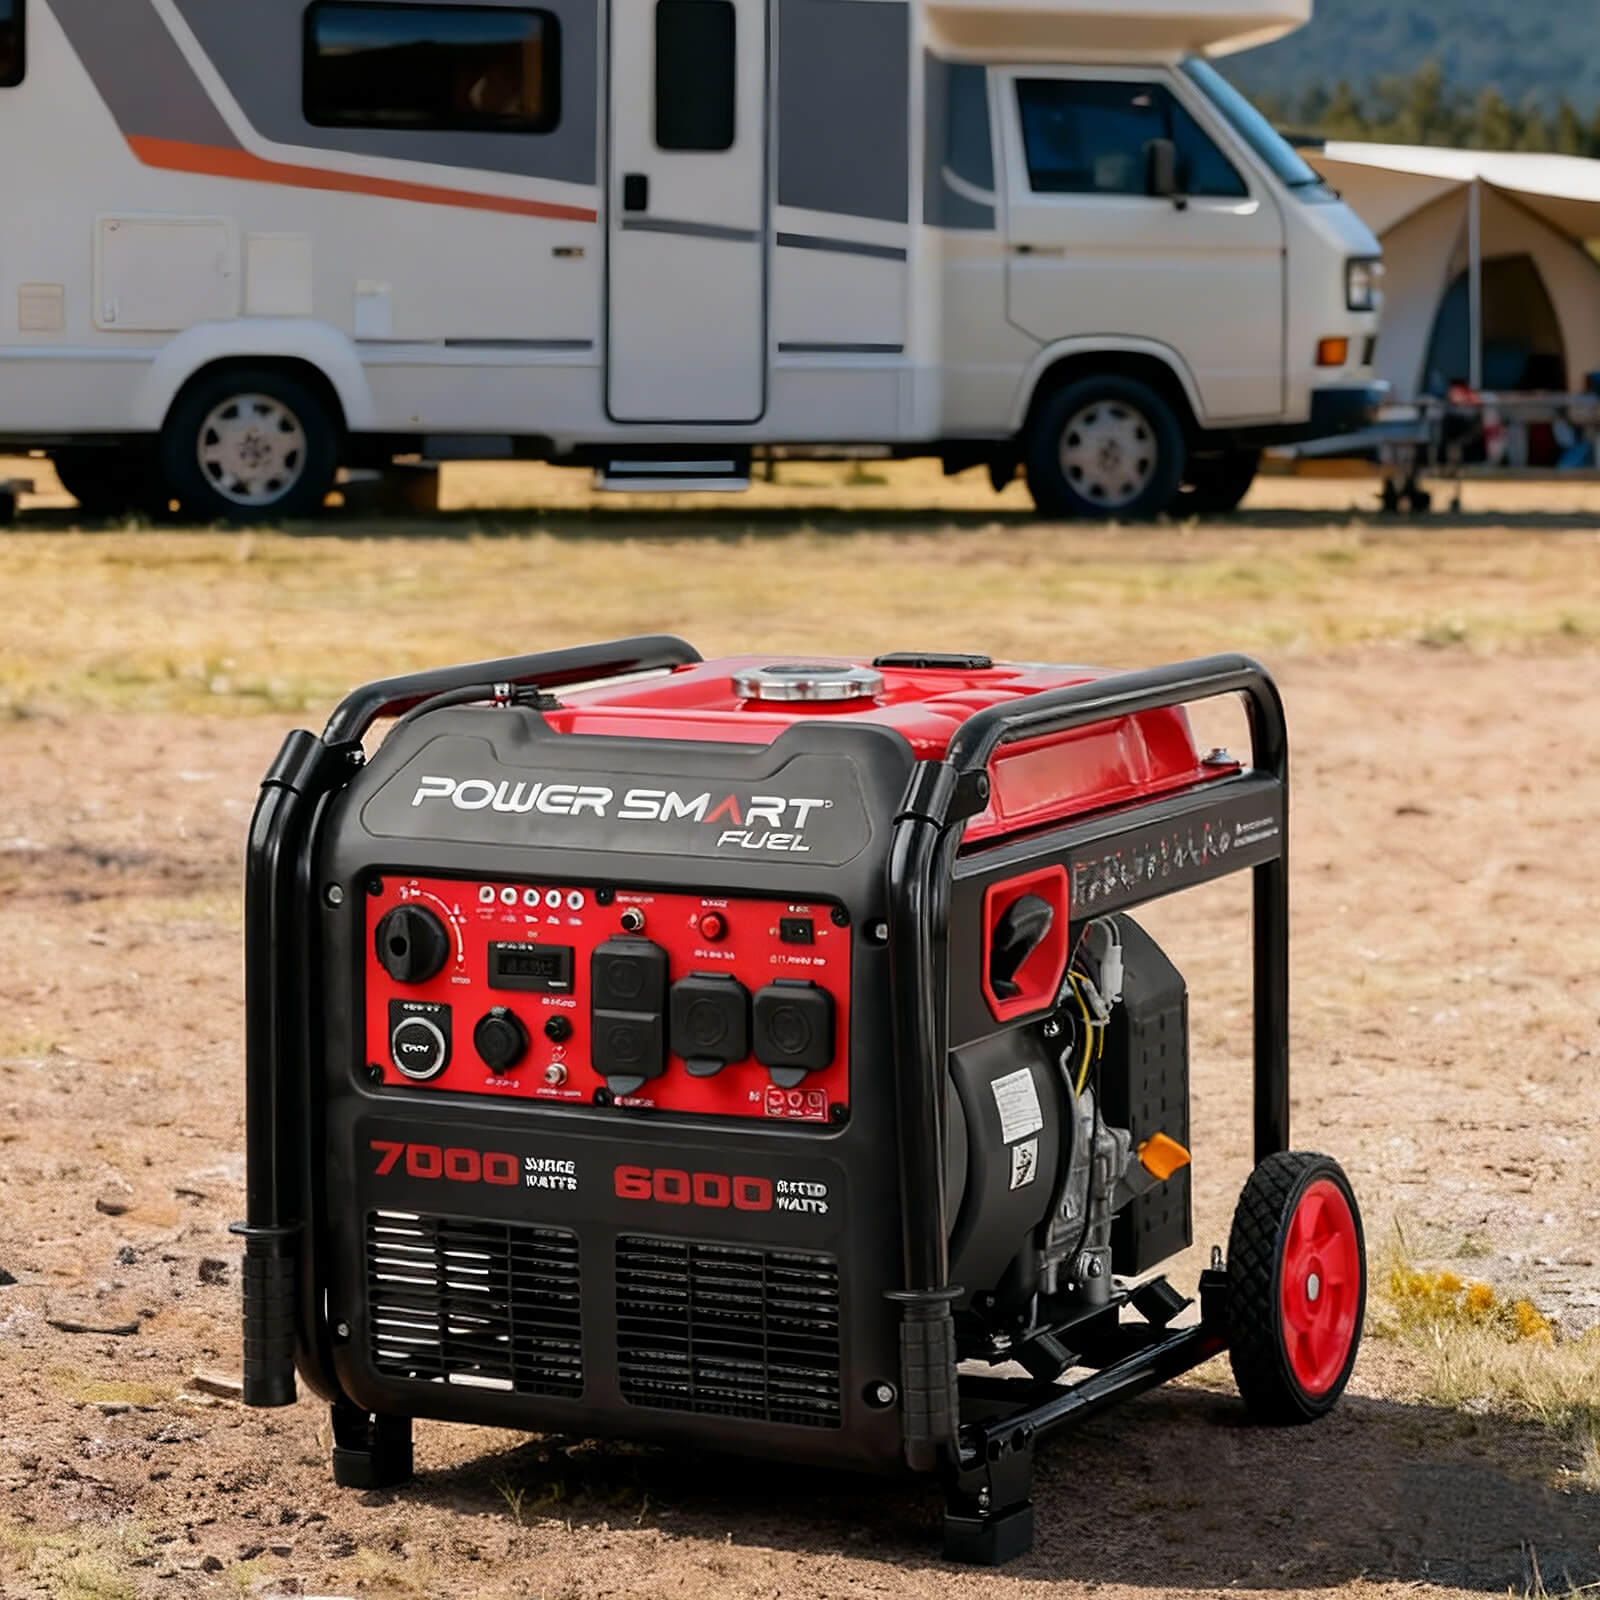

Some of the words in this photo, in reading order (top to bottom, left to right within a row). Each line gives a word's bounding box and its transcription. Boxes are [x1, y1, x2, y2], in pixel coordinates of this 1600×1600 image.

[411, 776, 614, 817] POWER
[617, 790, 826, 829] SMART
[716, 830, 811, 852] FUEL
[370, 1140, 520, 1187] 7000
[614, 1165, 773, 1211] 6000
